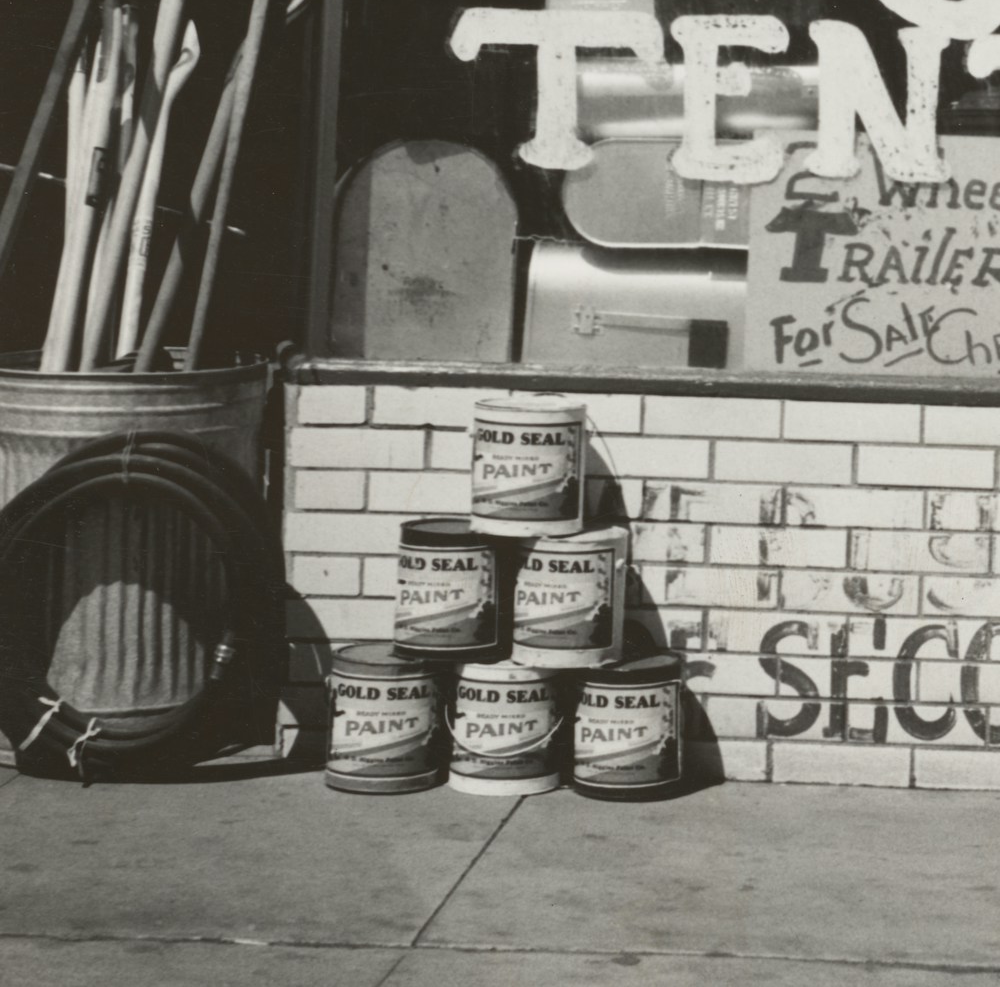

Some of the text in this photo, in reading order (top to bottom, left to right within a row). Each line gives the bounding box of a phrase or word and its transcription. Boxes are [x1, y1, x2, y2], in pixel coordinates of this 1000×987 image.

[520, 432, 565, 446] SEAL
[482, 463, 553, 480] PAINT
[399, 555, 478, 572] OLD SEAL
[548, 559, 595, 574] SEAL
[400, 589, 464, 606] PAINT
[516, 590, 582, 607] PAINT
[337, 682, 430, 701] GOLD SEAL
[457, 685, 549, 704] GOLD SEAL
[580, 692, 661, 710] OLD SEAL
[345, 716, 419, 737] PAINT
[465, 719, 538, 739] PAINT
[580, 725, 649, 743] PAINT
